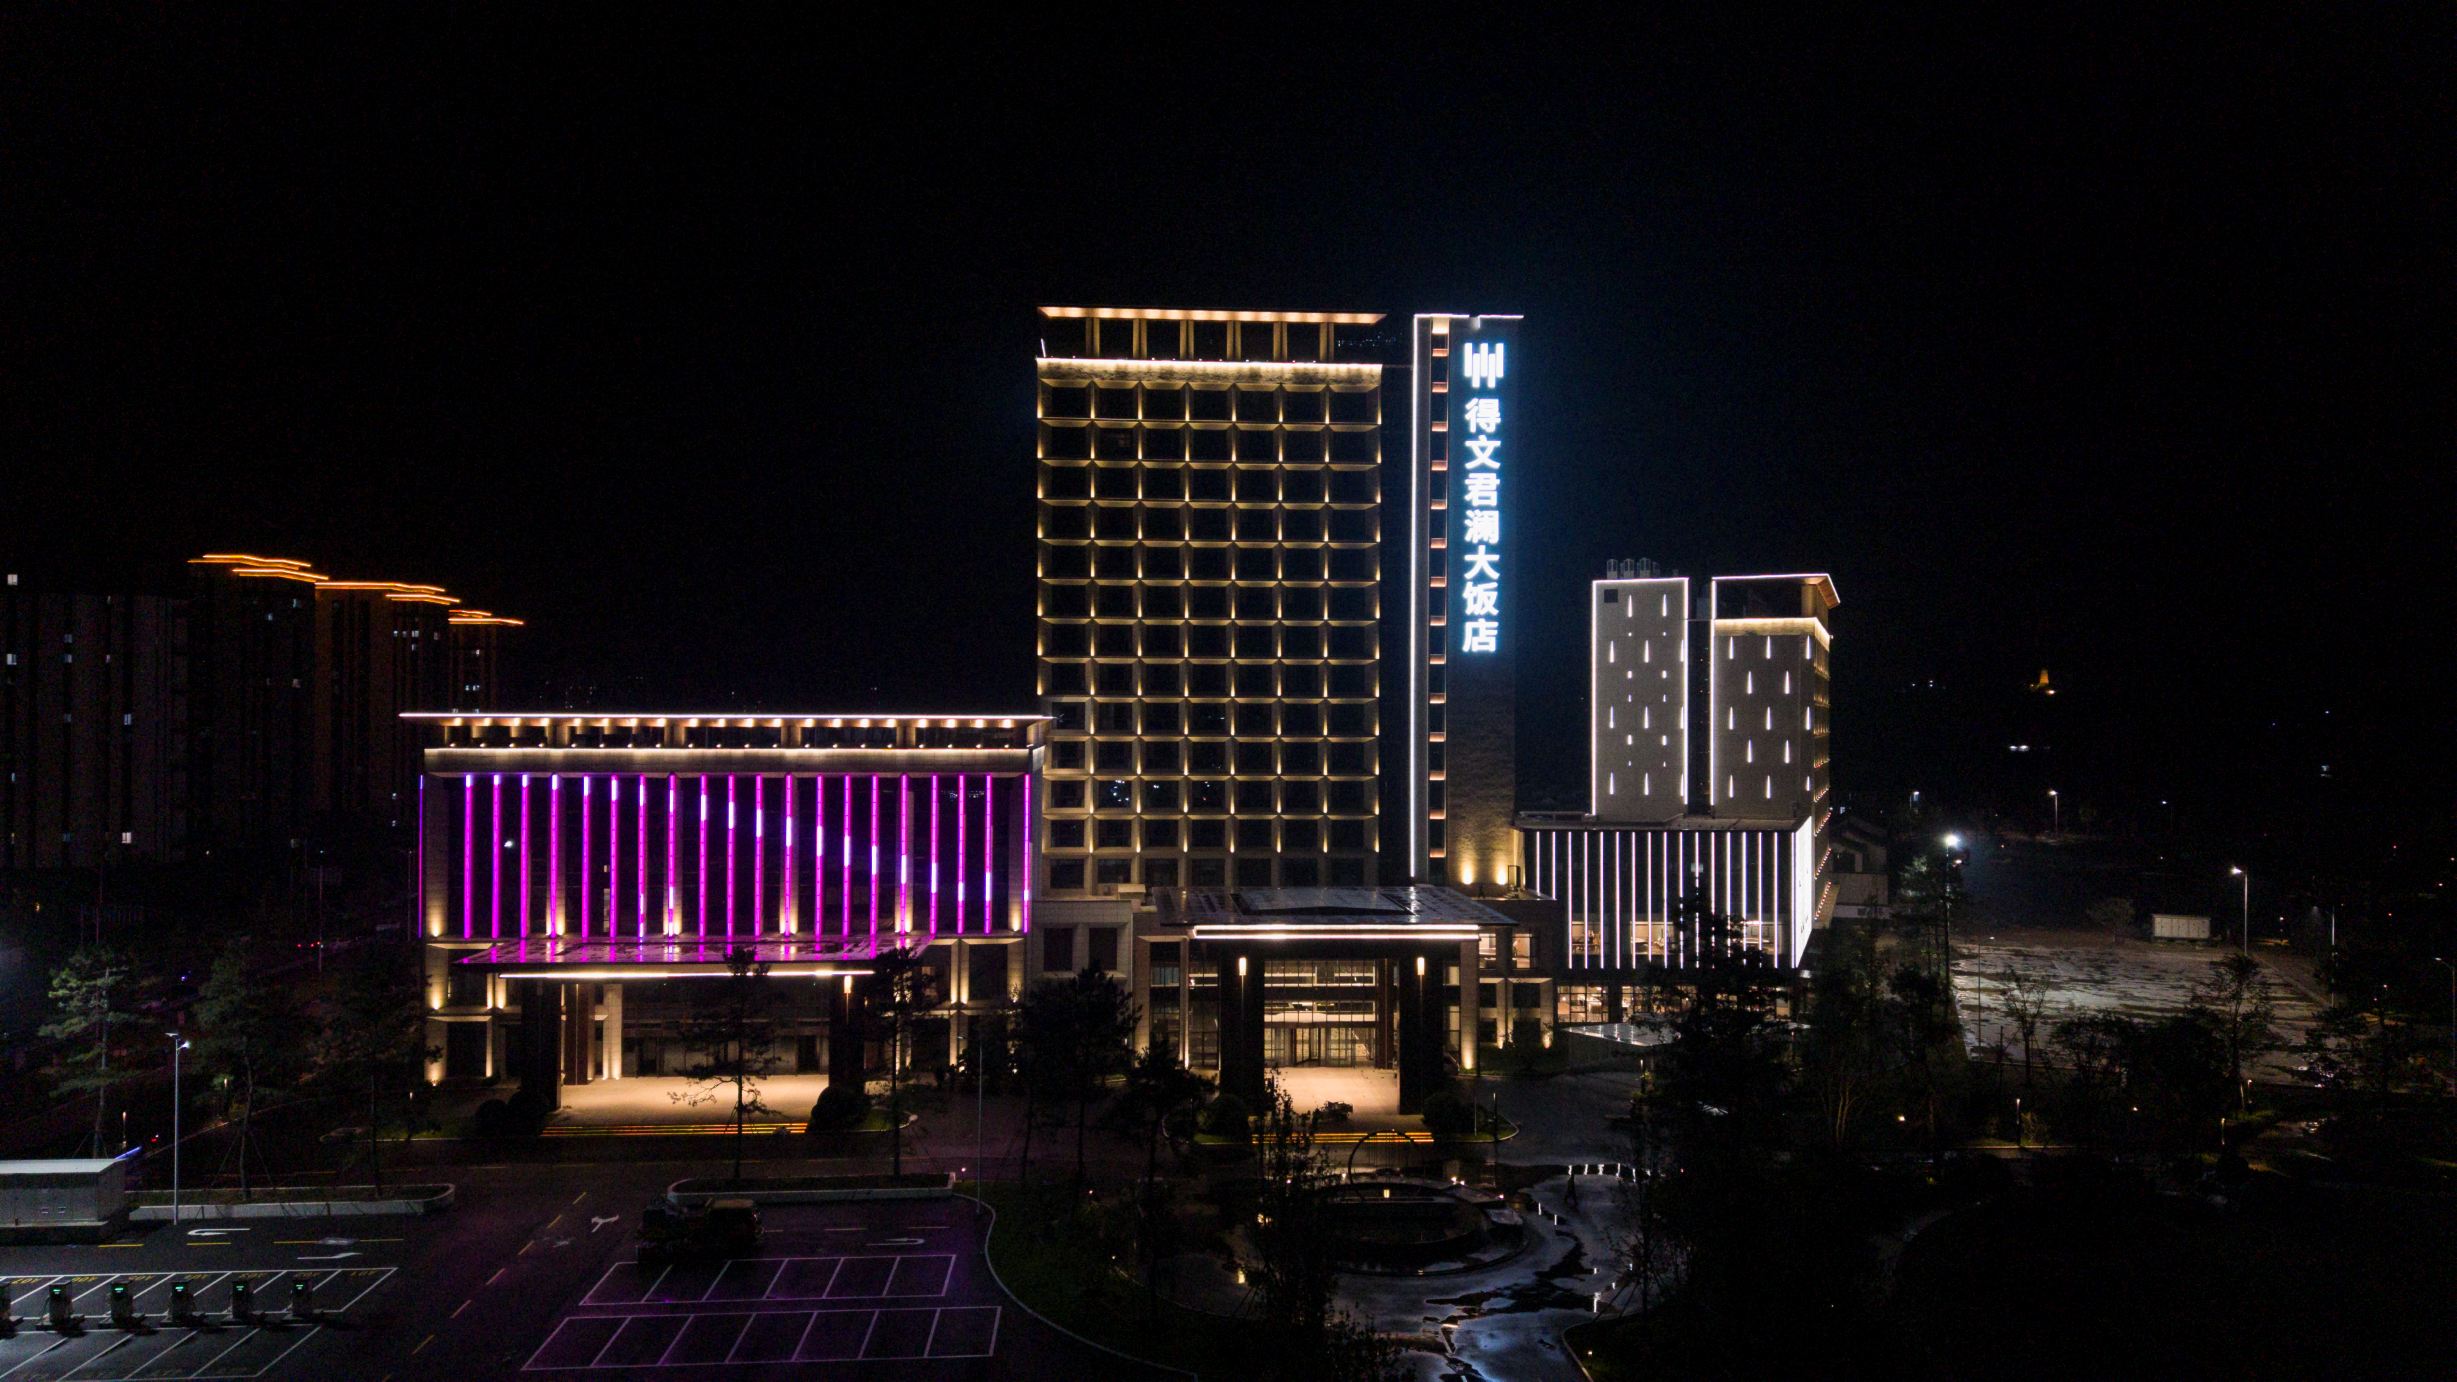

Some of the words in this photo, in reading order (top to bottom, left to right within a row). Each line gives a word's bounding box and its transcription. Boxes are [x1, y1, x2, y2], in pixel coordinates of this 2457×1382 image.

[1462, 398, 1501, 652] 得文君澜大饭店
